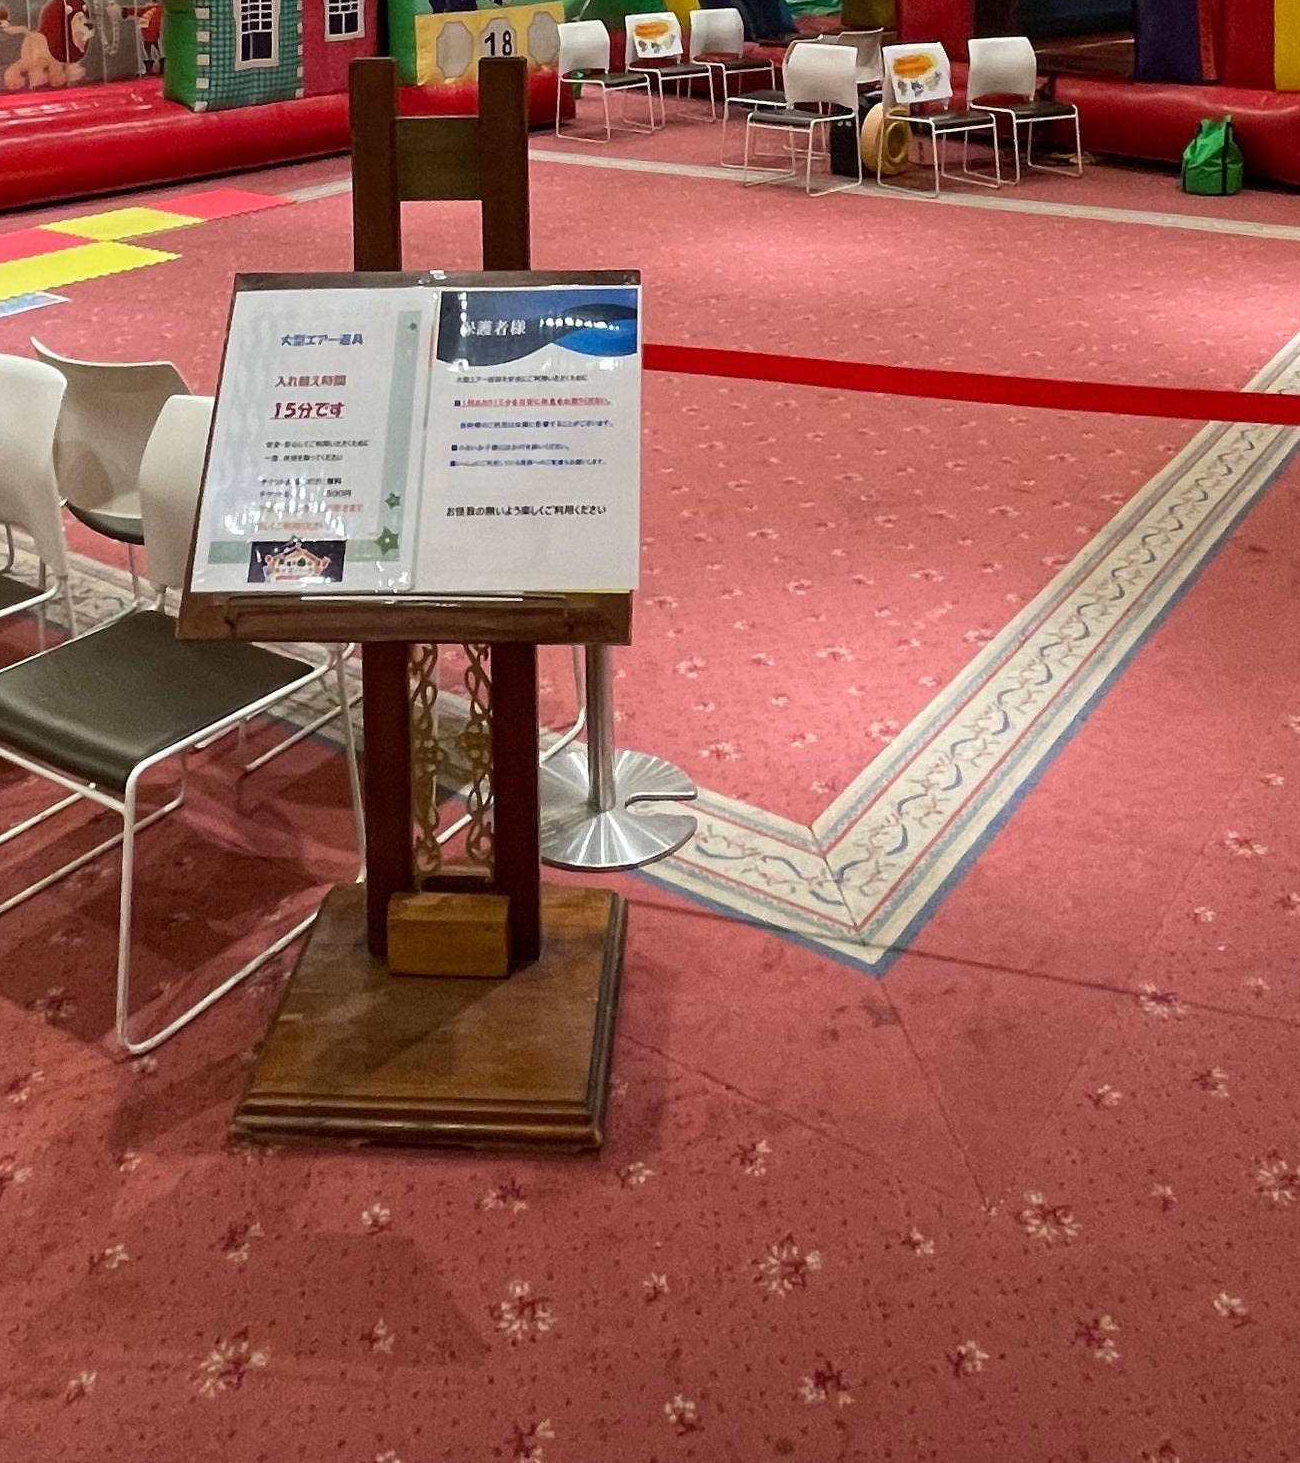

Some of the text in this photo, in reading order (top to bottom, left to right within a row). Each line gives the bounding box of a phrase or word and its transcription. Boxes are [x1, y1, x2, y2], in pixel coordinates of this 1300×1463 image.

[484, 30, 513, 57] 18
[281, 334, 364, 346] 大型エアー遊具
[275, 375, 347, 387] 入れ替え時間
[274, 401, 345, 418] 15分です
